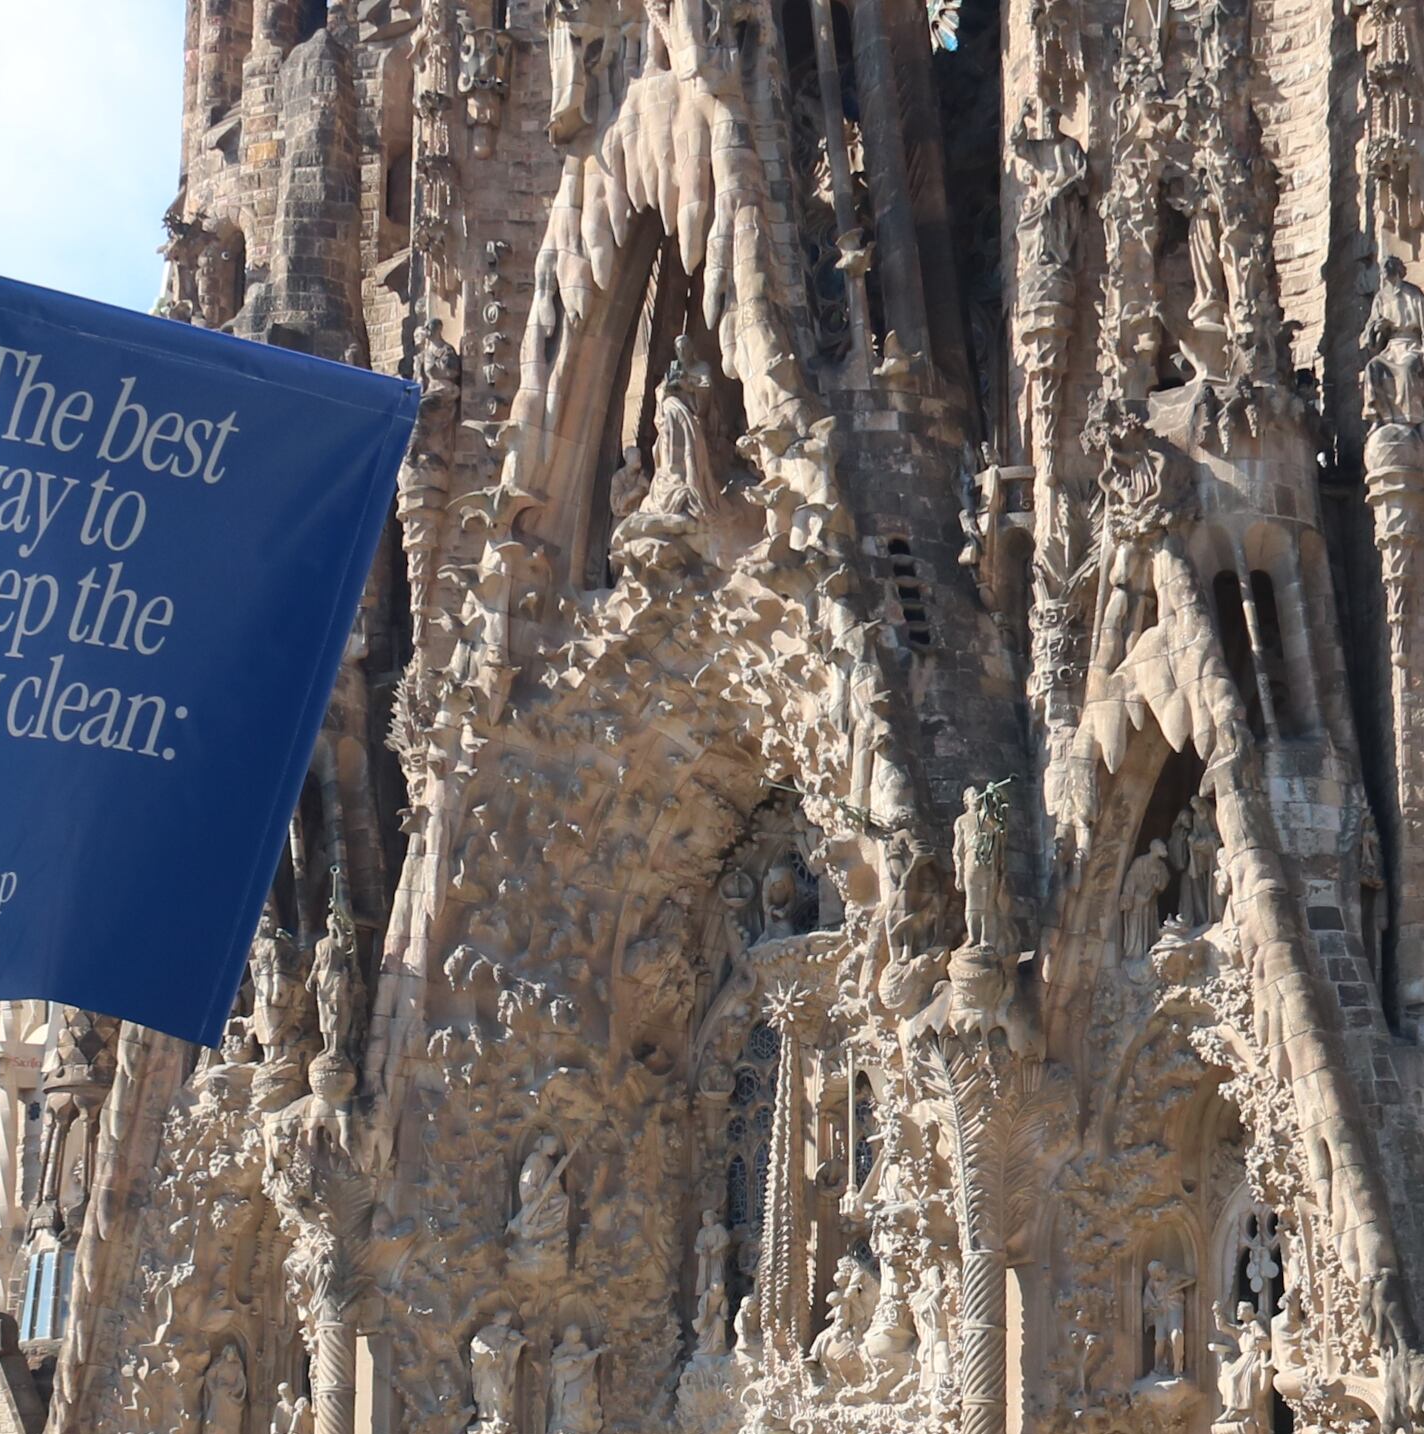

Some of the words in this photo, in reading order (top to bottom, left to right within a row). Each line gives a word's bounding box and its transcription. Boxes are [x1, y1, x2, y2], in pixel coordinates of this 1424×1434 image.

[96, 377, 240, 484] best
[79, 469, 147, 552] to
[68, 562, 175, 655] the
